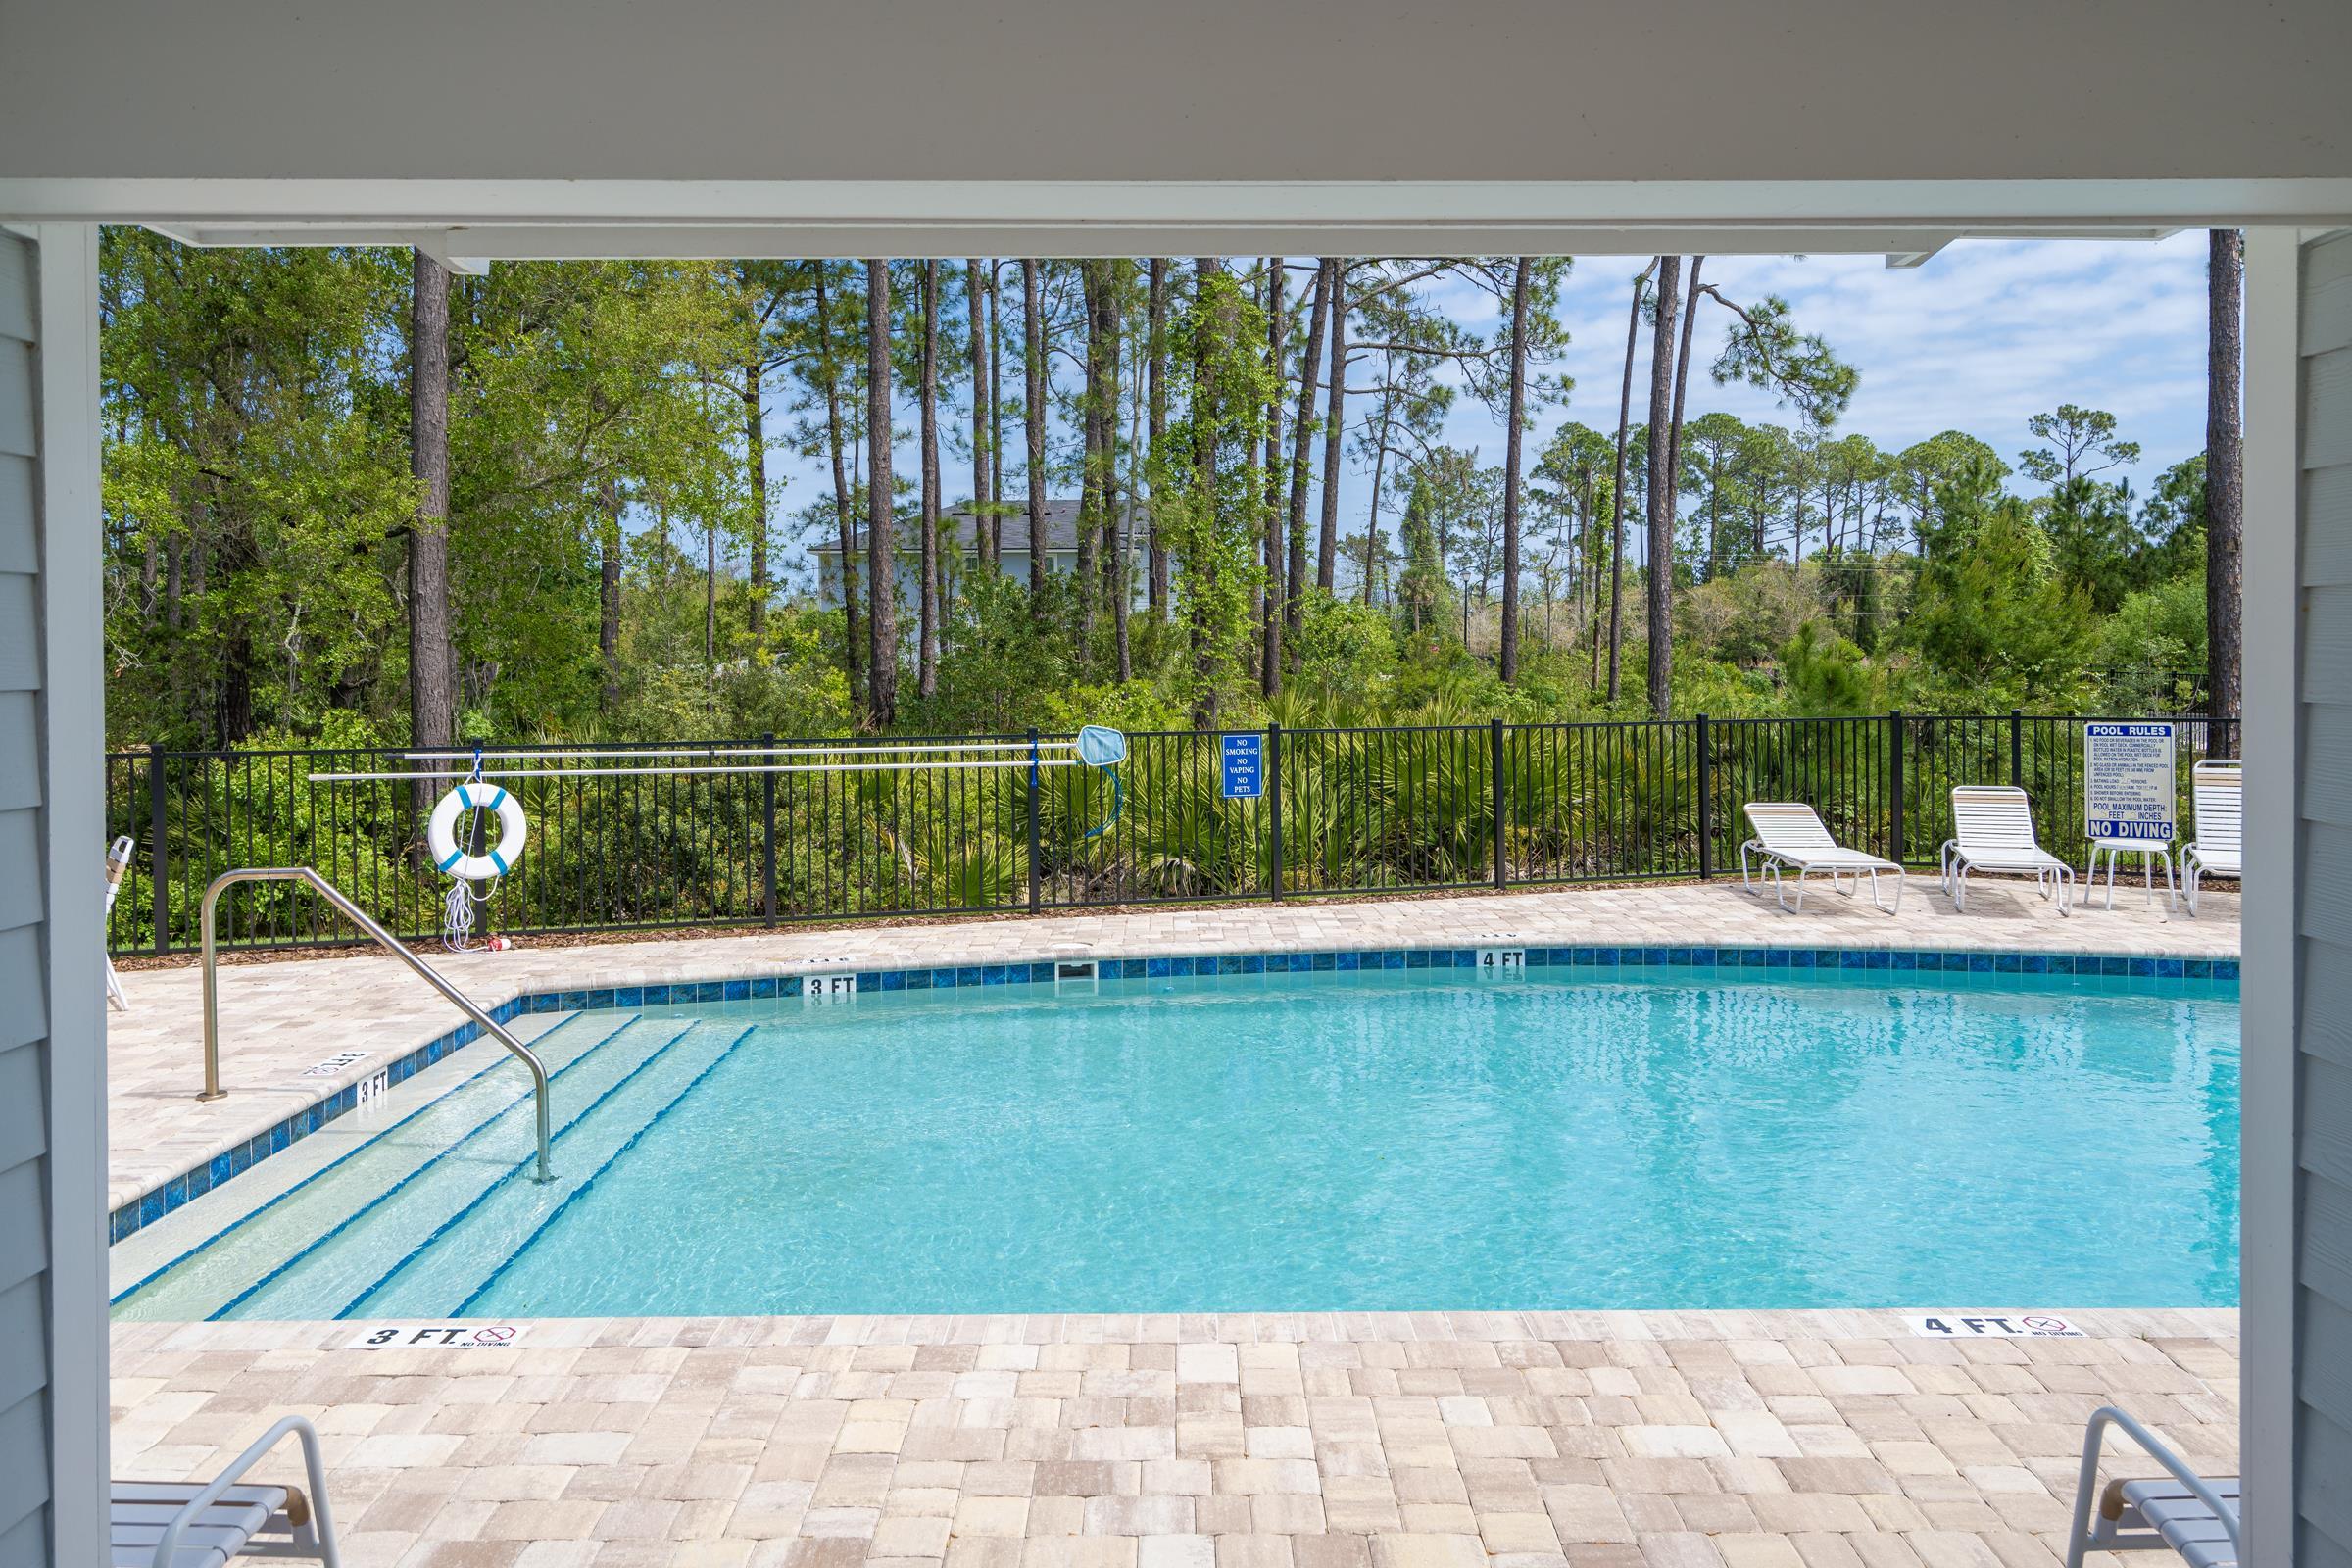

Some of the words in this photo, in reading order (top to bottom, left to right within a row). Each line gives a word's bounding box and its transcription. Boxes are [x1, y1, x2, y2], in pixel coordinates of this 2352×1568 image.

[2093, 726, 2123, 735] POOL
[2090, 821, 2112, 836] NO
[2119, 822, 2170, 838] DIVING
[1483, 952, 1494, 967] 4
[1502, 952, 1522, 966] FT
[811, 979, 822, 994] 3
[832, 977, 854, 993] FT
[362, 1081, 368, 1102] 3
[373, 1071, 386, 1096] FT
[1926, 1318, 1953, 1334] 4
[1961, 1318, 2023, 1334] FT.
[367, 1329, 399, 1344] 3
[408, 1329, 467, 1344] FT.
